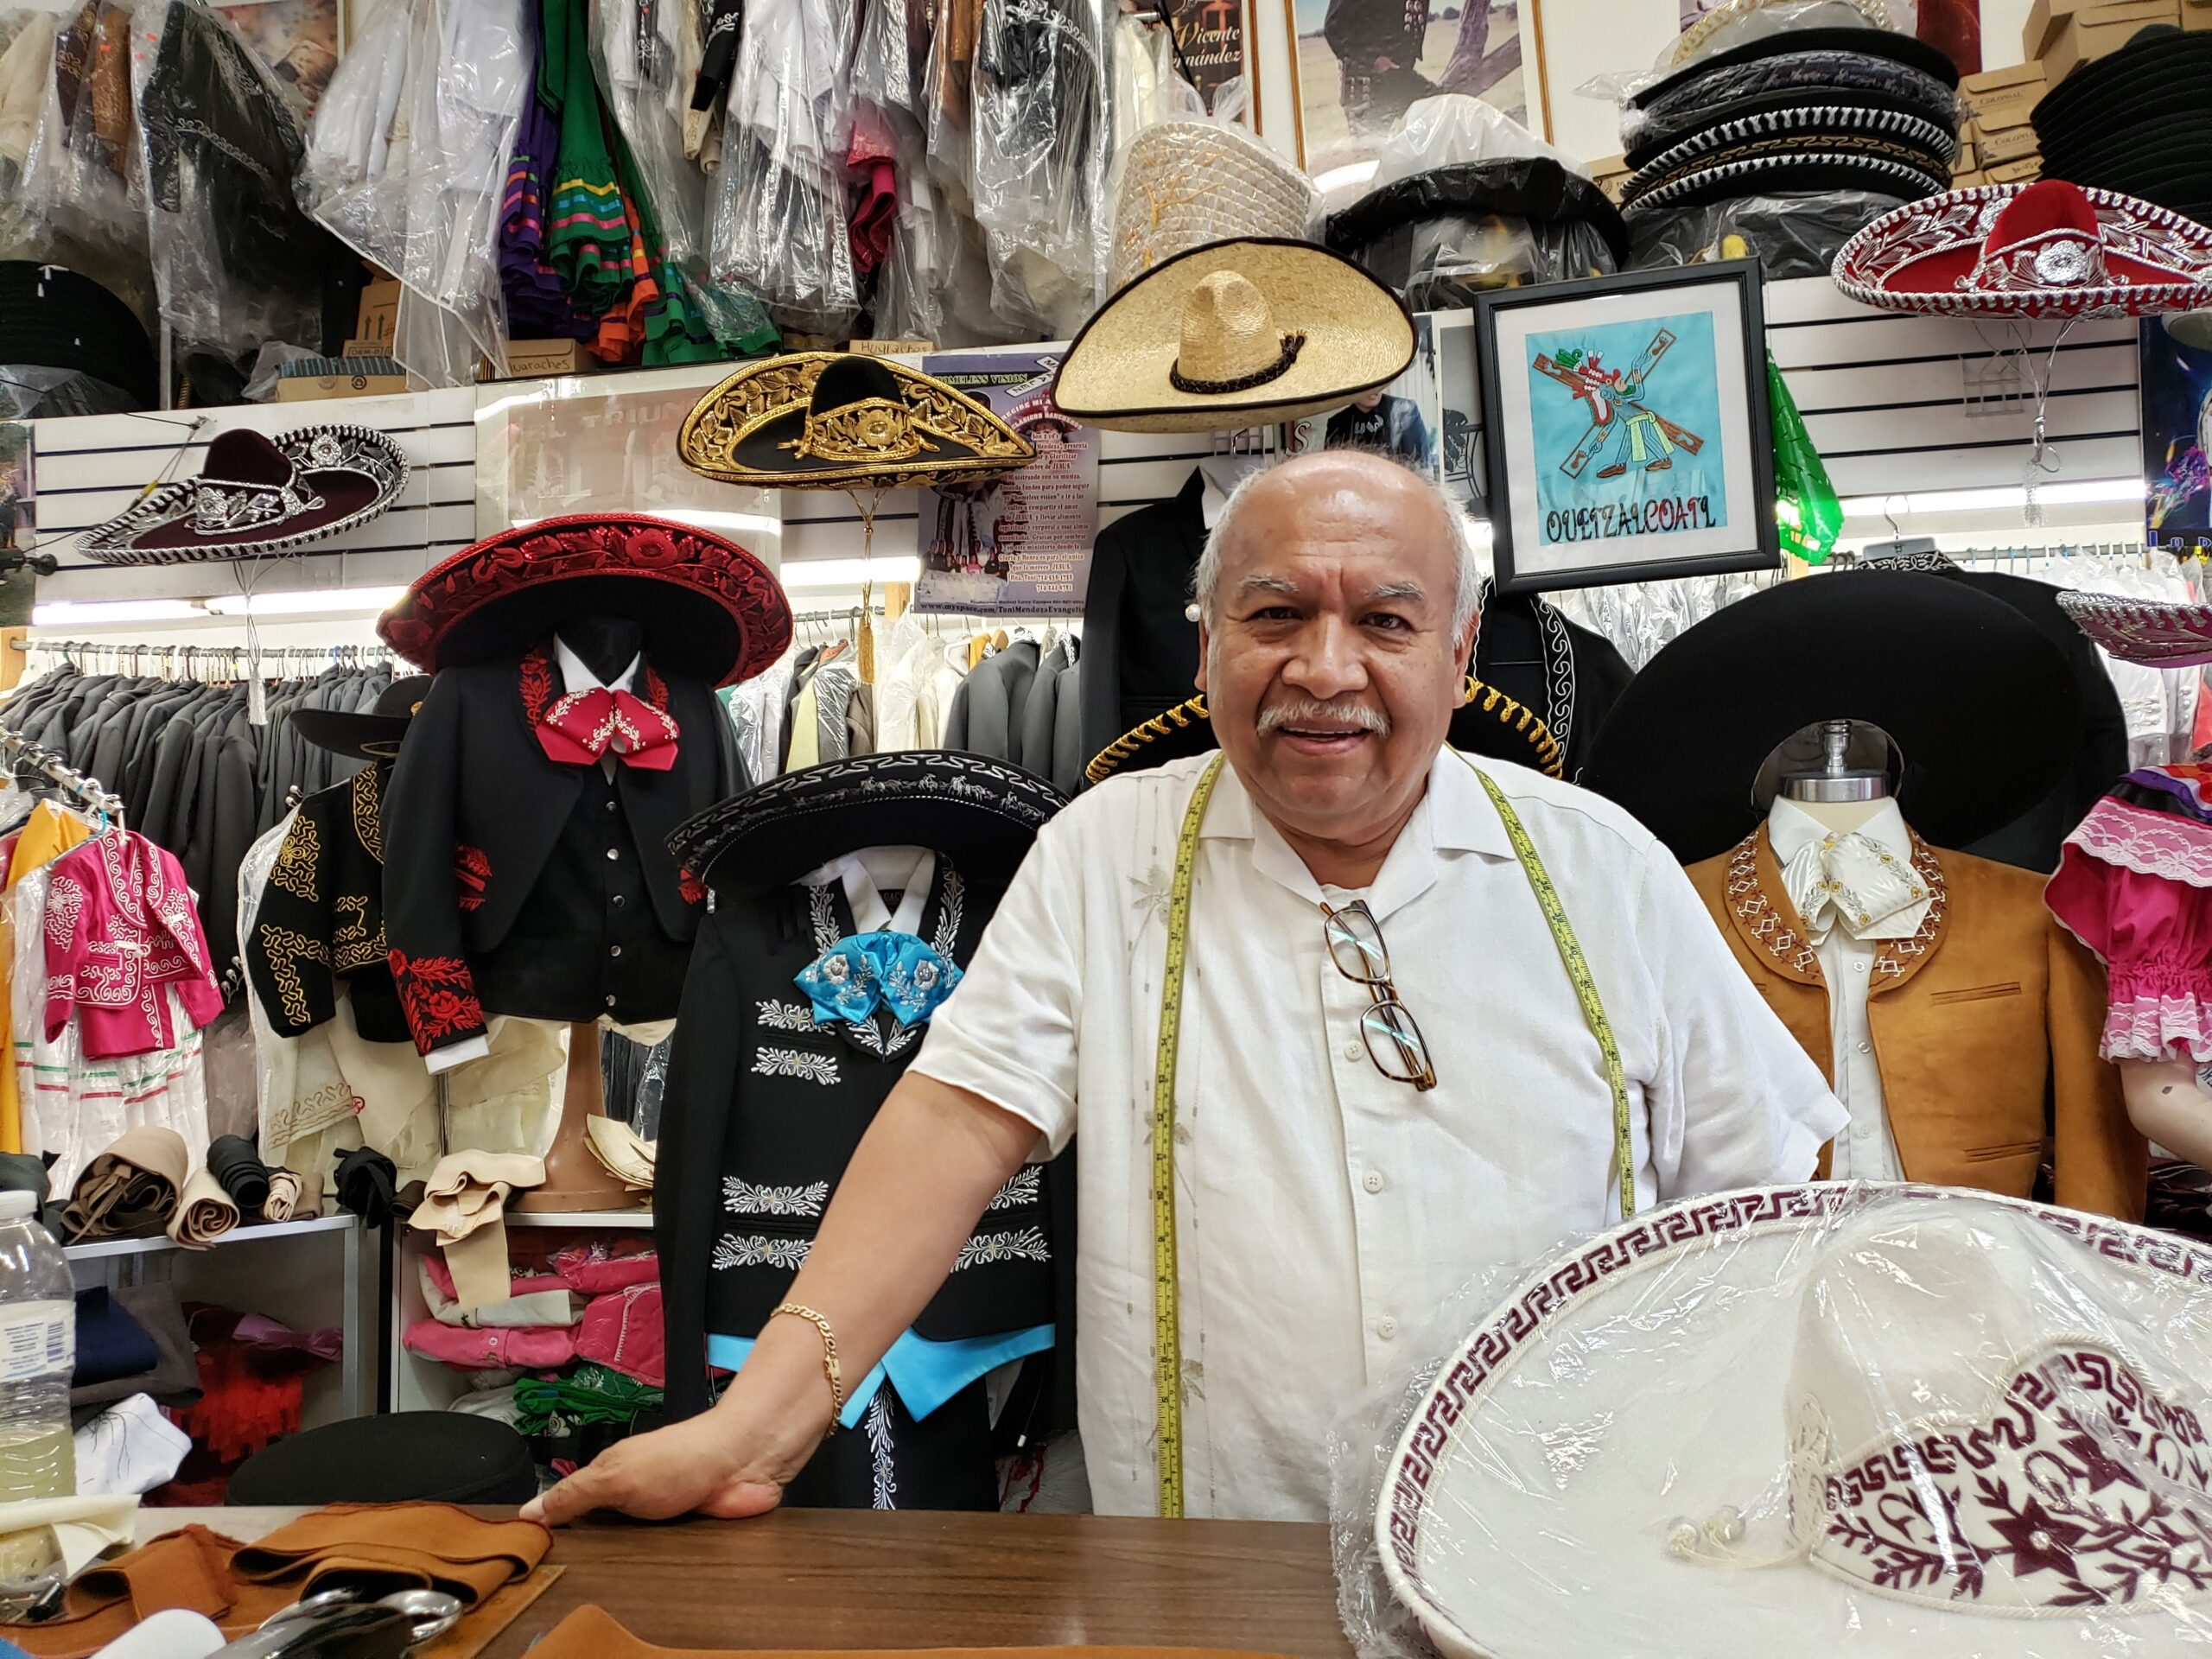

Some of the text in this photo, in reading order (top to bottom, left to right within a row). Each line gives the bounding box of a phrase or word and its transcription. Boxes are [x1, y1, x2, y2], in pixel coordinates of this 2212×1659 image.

[1174, 22, 1240, 50] Vicente
[1173, 43, 1242, 68] ernández
[1995, 132, 2034, 145] COLONIA
[990, 373, 1028, 384] VISION
